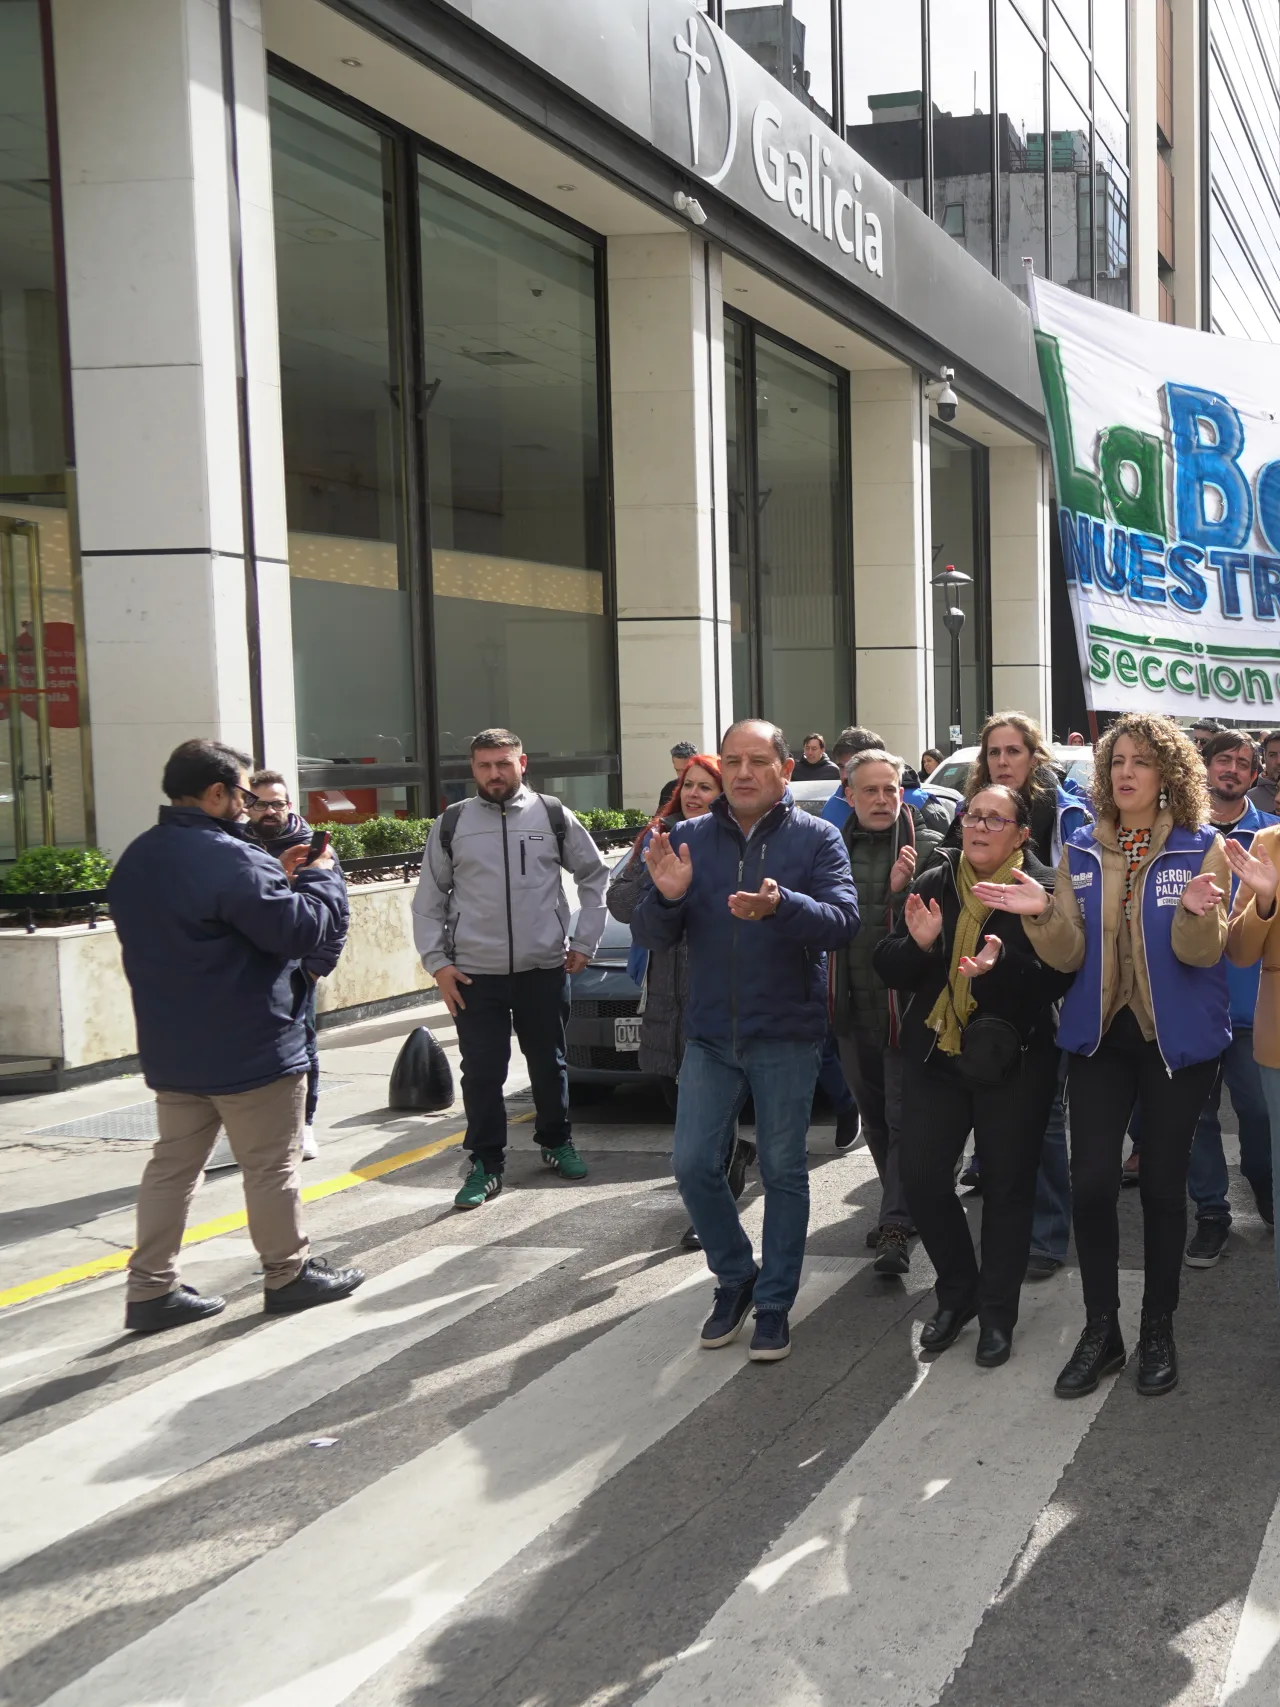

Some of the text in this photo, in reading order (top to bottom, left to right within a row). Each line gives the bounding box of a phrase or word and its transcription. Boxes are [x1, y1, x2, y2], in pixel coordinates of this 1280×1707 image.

[751, 101, 884, 278] Galicia
[1155, 868, 1192, 884] SERGIO
[1155, 883, 1187, 897] PALAZ
